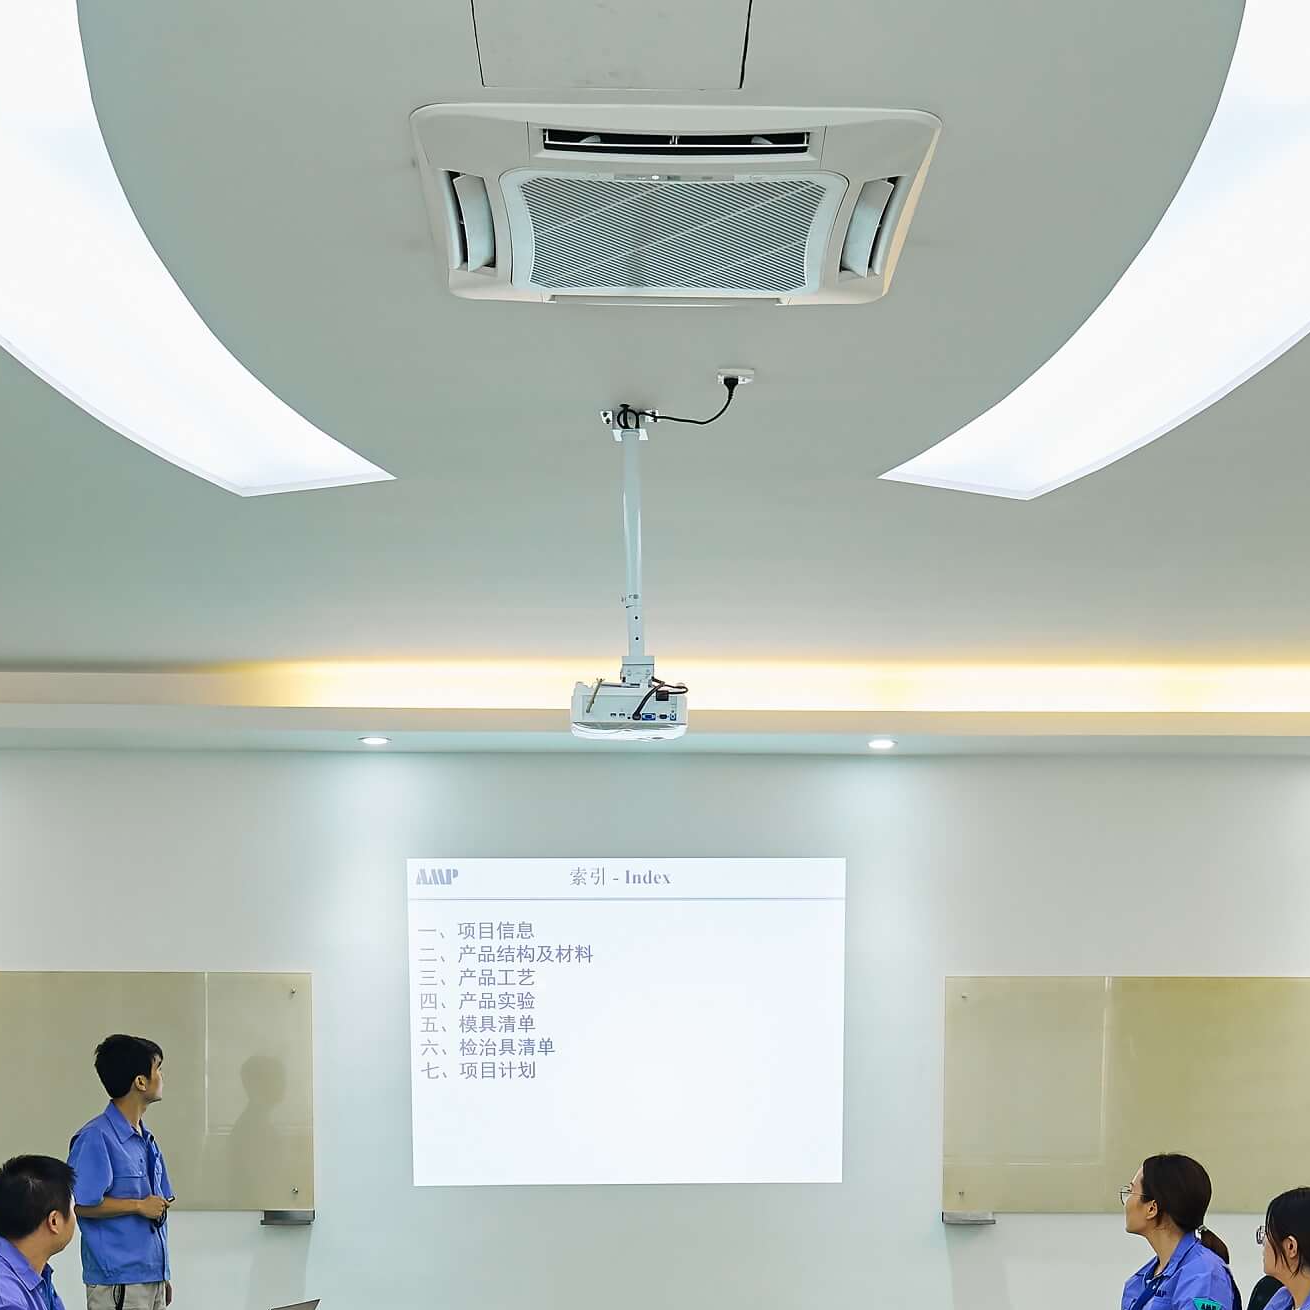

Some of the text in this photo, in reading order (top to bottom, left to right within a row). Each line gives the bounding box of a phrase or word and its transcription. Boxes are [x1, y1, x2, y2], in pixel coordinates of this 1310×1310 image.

[416, 868, 459, 885] AMP
[570, 866, 606, 886] 索引
[625, 869, 671, 884] Index
[417, 921, 535, 940] 一、项目信息
[417, 944, 594, 963] 二、产品结构及材料
[419, 968, 536, 986] 三、产品工艺
[420, 991, 536, 1010] 四、产品实验
[420, 1014, 536, 1033] 五、模具清单
[420, 1060, 536, 1079] 七、项目计划
